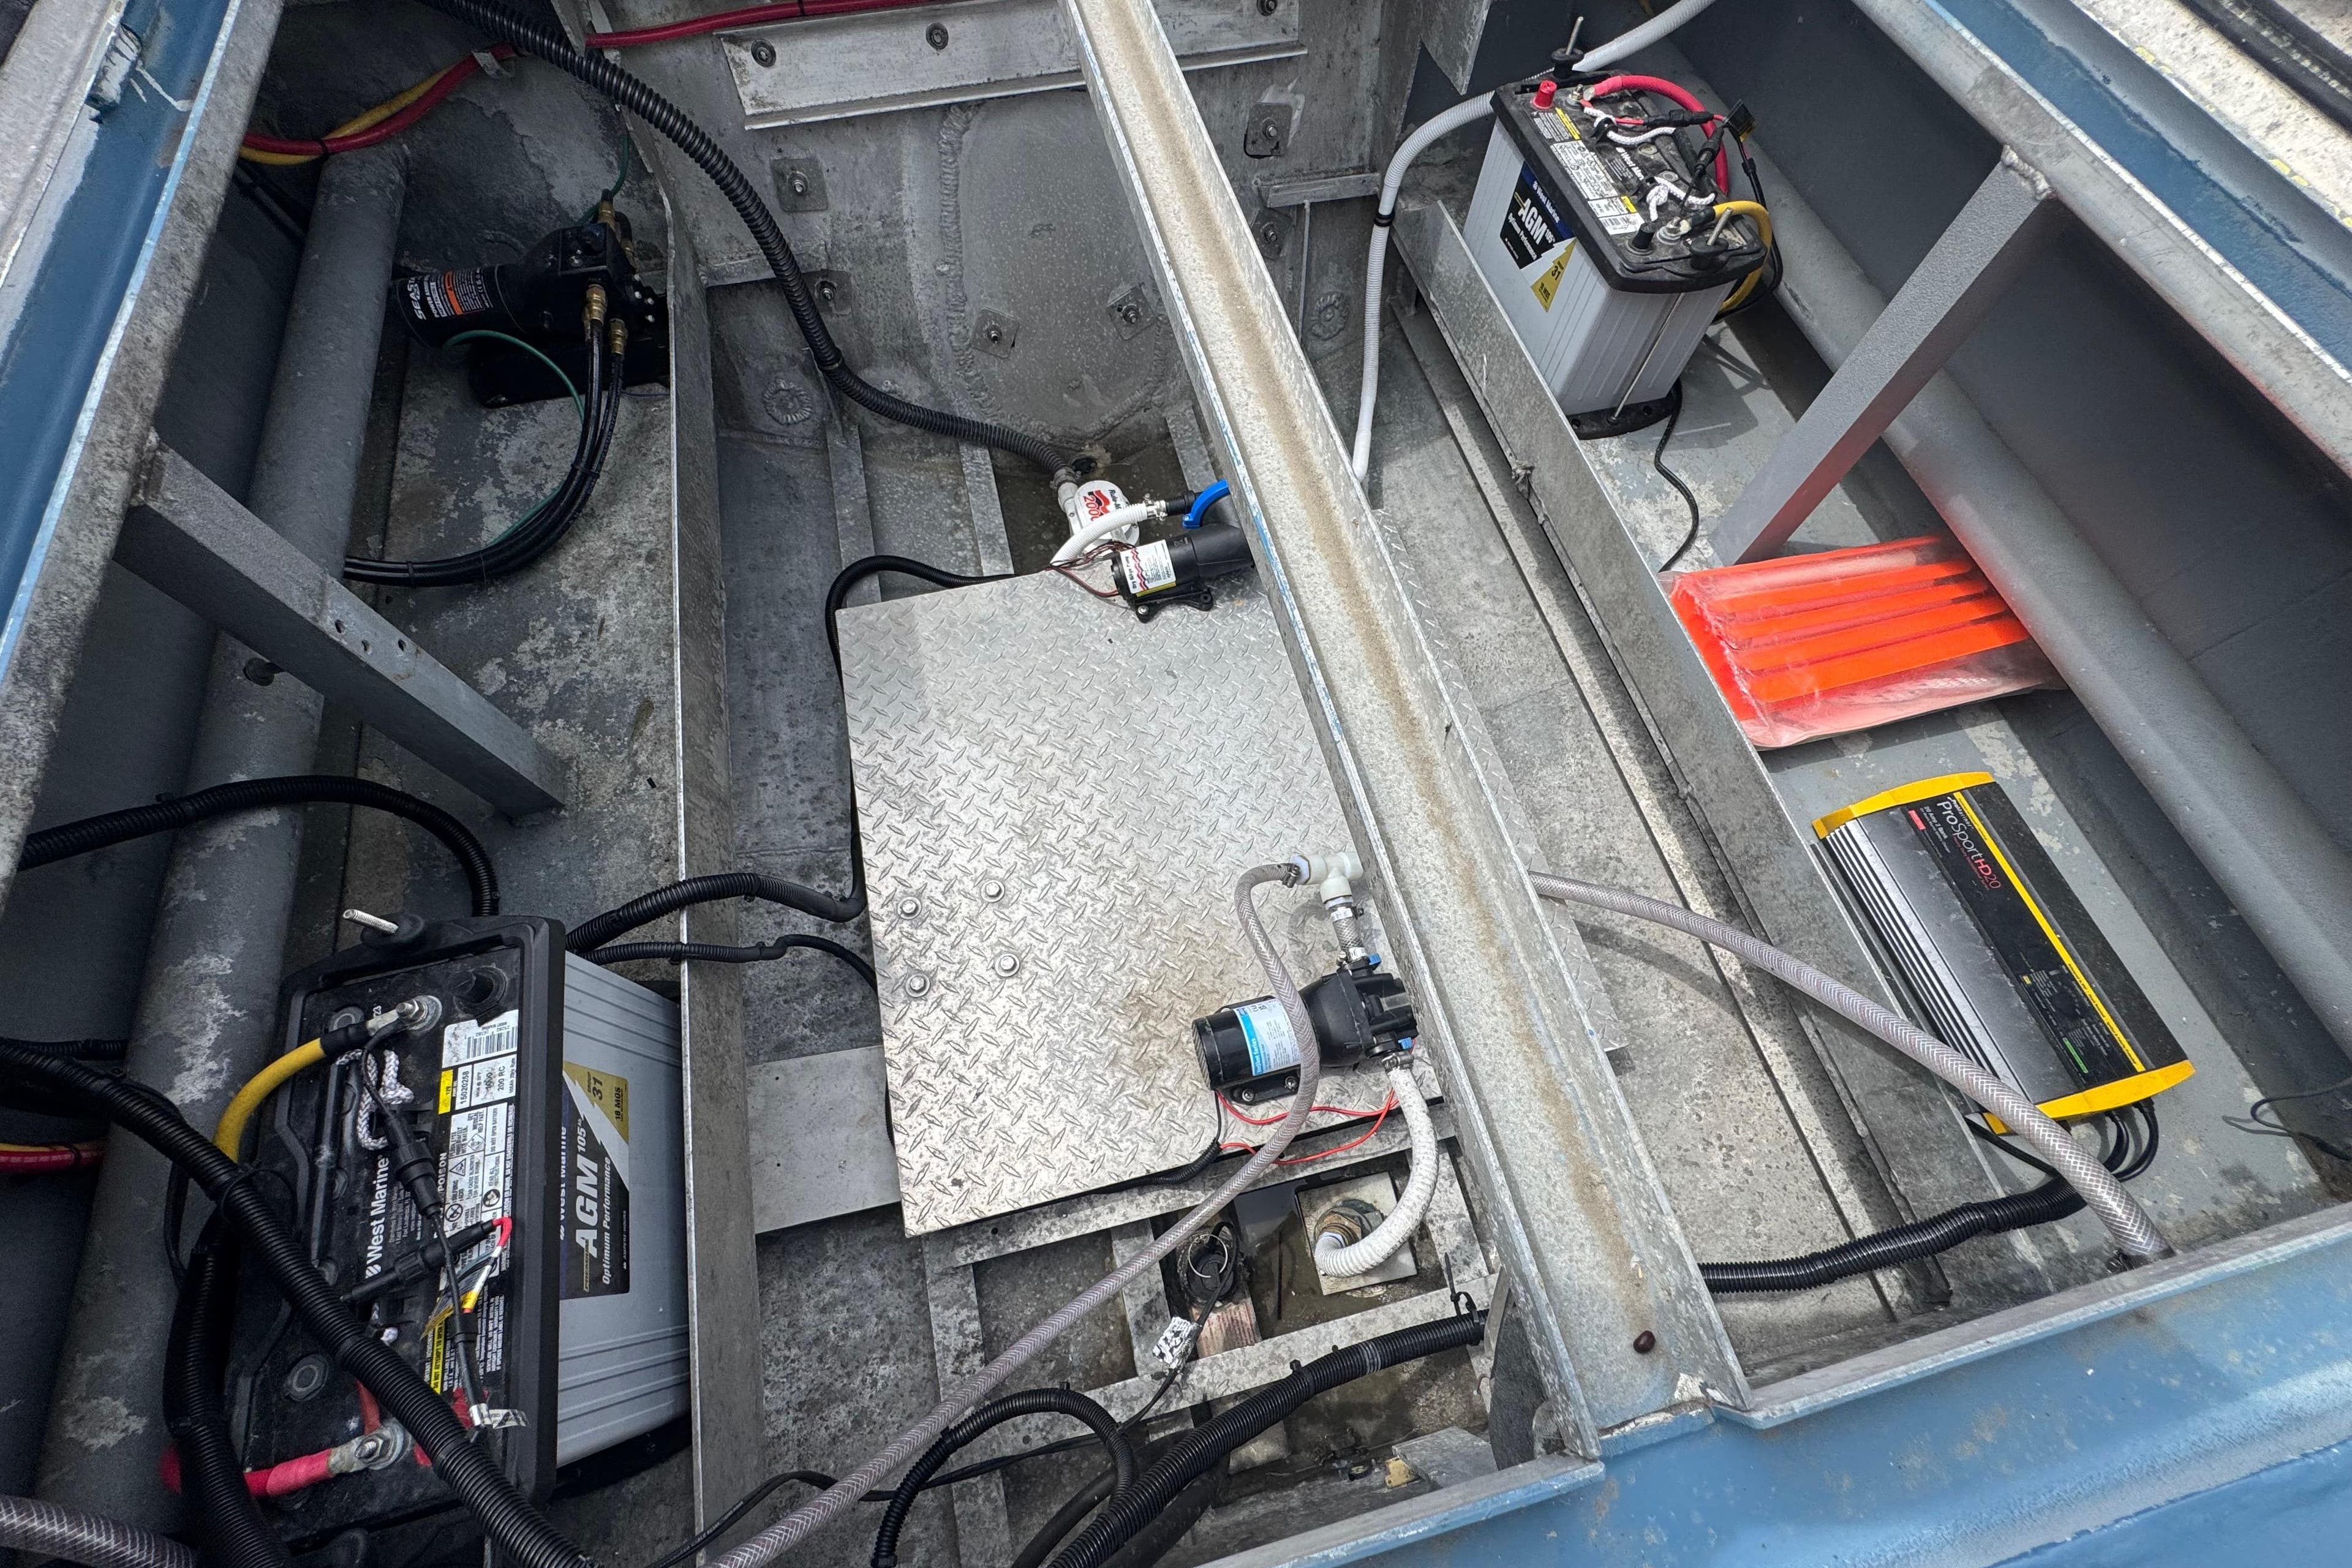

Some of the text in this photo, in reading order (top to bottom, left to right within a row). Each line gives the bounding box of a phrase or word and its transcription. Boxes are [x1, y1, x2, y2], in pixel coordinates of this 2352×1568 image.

[1537, 187, 1560, 224] West Marine
[1518, 198, 1548, 245] AGM
[1551, 266, 1561, 281] 31
[407, 276, 427, 320] SEASTA
[426, 296, 440, 318] POWER
[1126, 567, 1135, 580] Bilge
[1928, 812, 1938, 823] Amp
[1938, 827, 1948, 839] Bank
[498, 1065, 505, 1076] RC
[460, 1070, 469, 1104] 15020258
[592, 1077, 603, 1100] 31
[614, 1110, 621, 1119] 18
[577, 1126, 586, 1152] 105
[366, 1158, 389, 1264] West Marine
[575, 1153, 598, 1258] AGM
[602, 1156, 612, 1284] Optimum Performance
